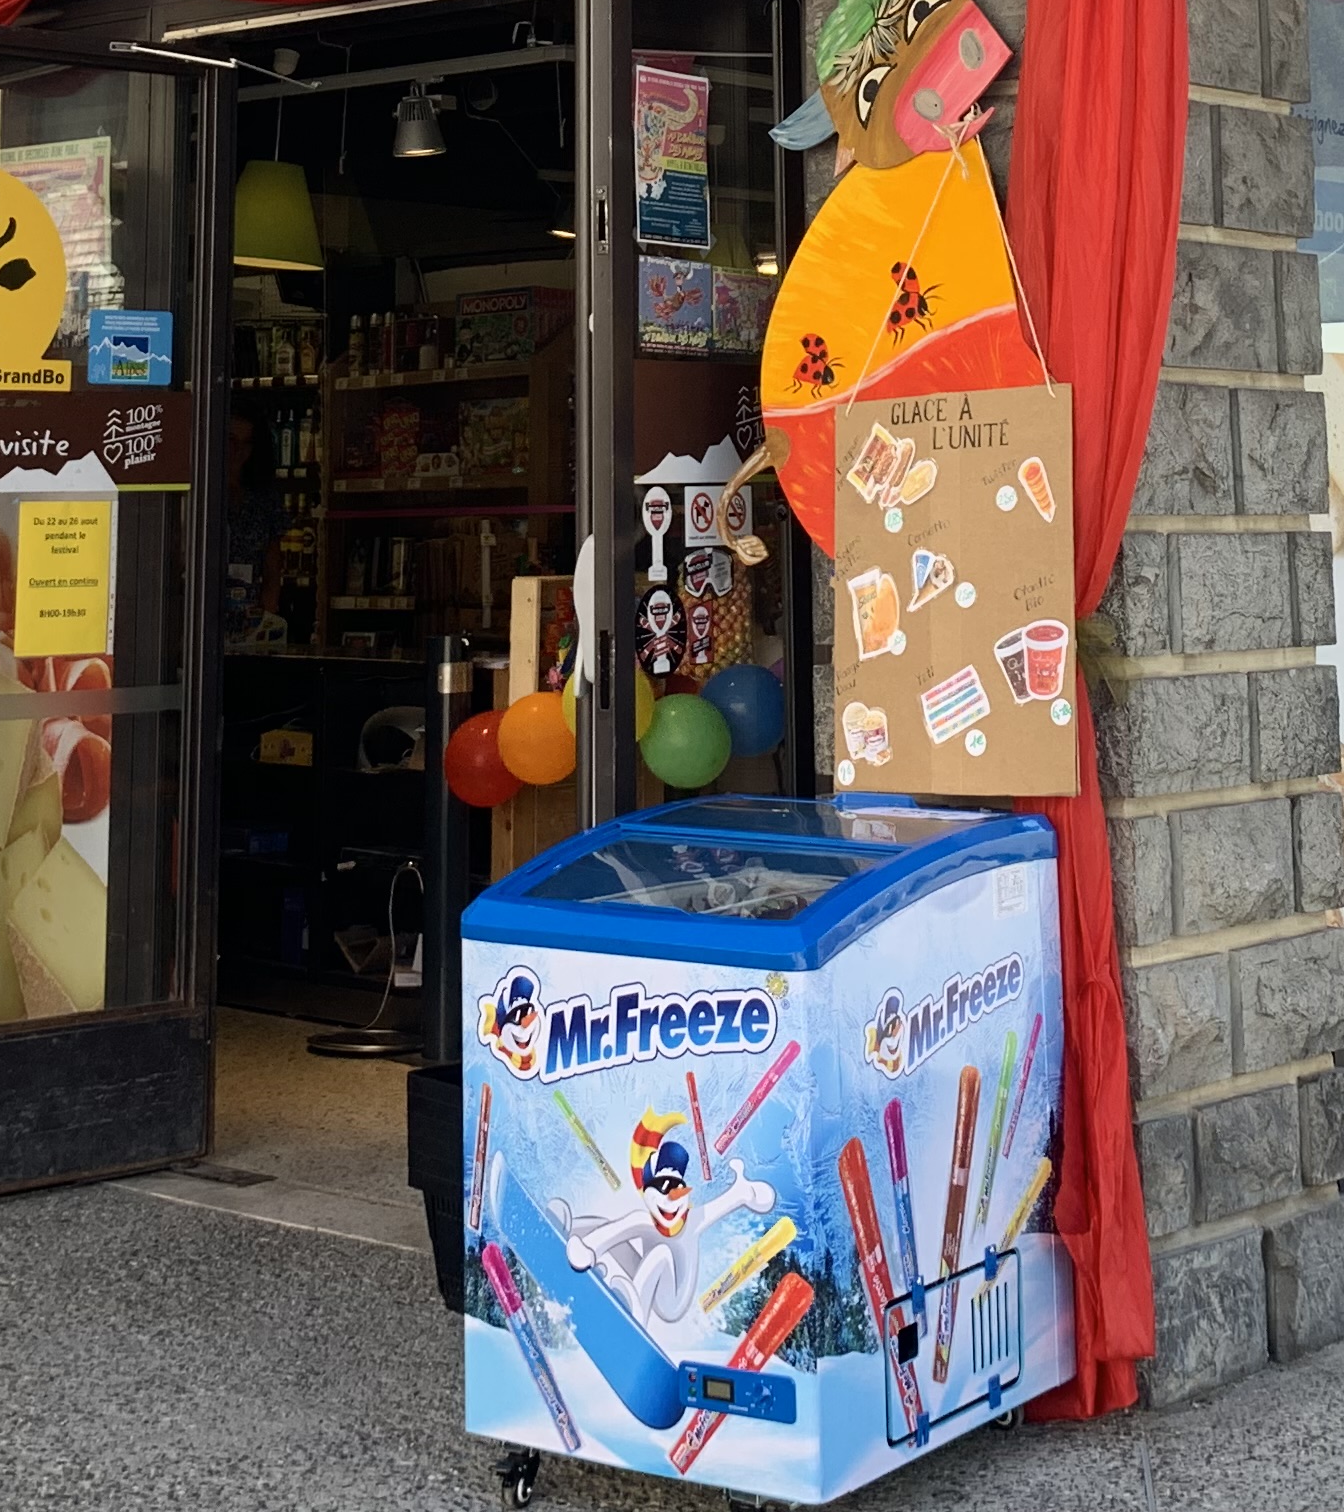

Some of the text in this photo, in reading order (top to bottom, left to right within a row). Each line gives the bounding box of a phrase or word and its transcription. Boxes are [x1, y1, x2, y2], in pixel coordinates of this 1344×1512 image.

[462, 292, 529, 315] MONOPOLY
[891, 393, 973, 426] GLACE À
[0, 429, 70, 457] visite
[932, 418, 1010, 450] L'UNITÉ
[124, 450, 157, 470] plaisir
[907, 958, 1022, 1063] Mr.Freeze
[549, 993, 770, 1077] Mr.Freeze
